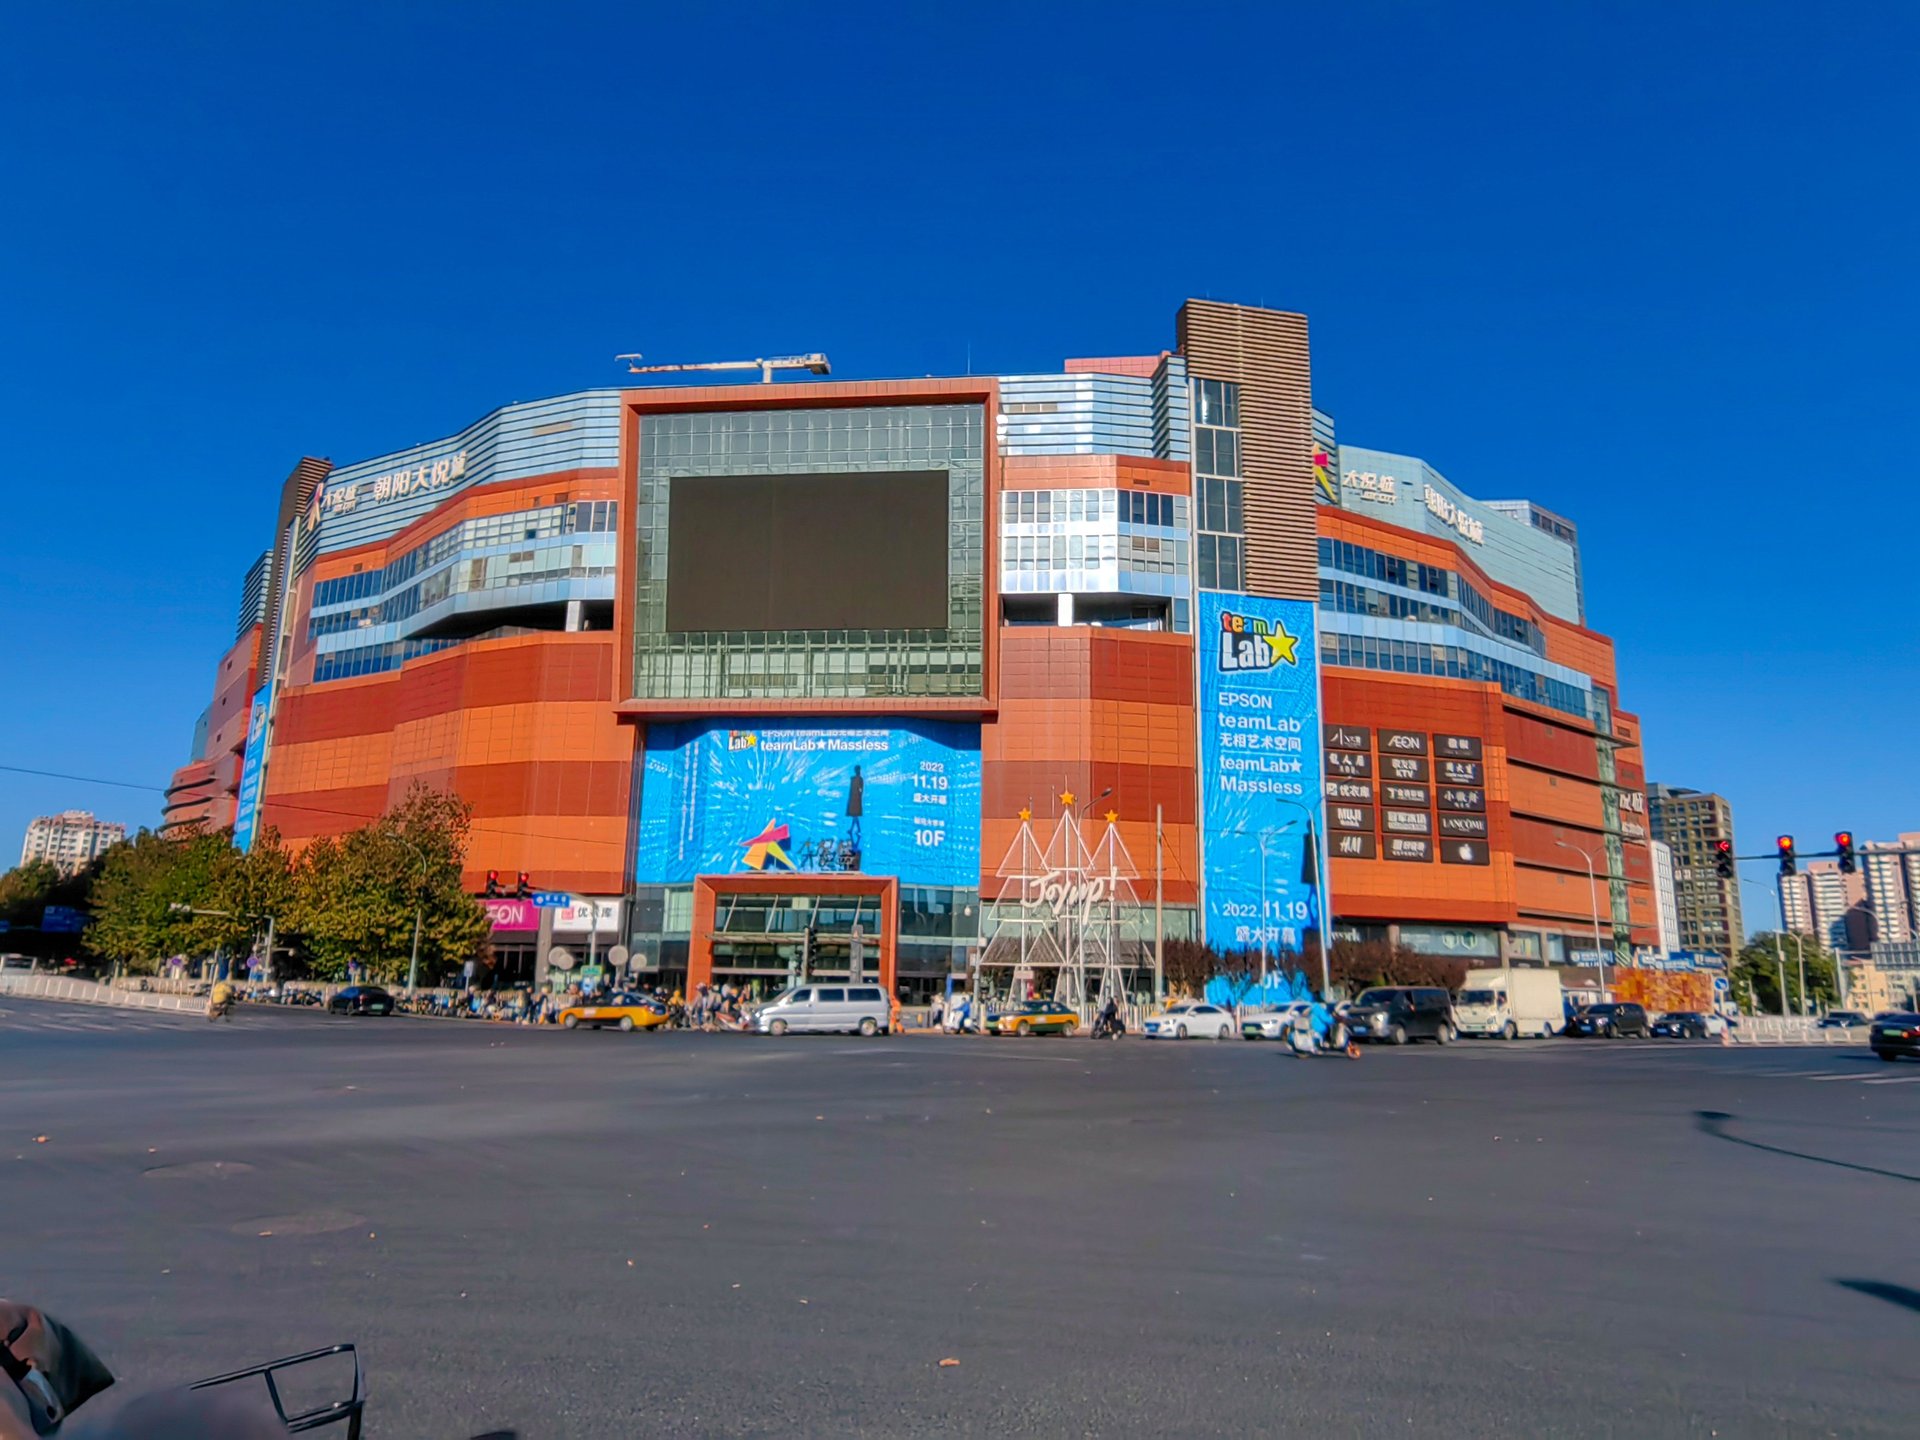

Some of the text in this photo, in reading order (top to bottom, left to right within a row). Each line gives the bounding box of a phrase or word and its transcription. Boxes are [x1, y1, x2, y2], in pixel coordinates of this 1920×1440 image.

[1222, 612, 1268, 635] team
[1222, 632, 1270, 669] Lab
[1218, 692, 1273, 709] EPSON
[1218, 711, 1300, 732] teamLab
[827, 740, 889, 751] Massless
[1219, 732, 1302, 752] 无相艺术空间
[920, 761, 944, 772] 2022
[912, 774, 948, 790] 11.19
[1220, 776, 1303, 795] Massless
[914, 829, 945, 846] 10F
